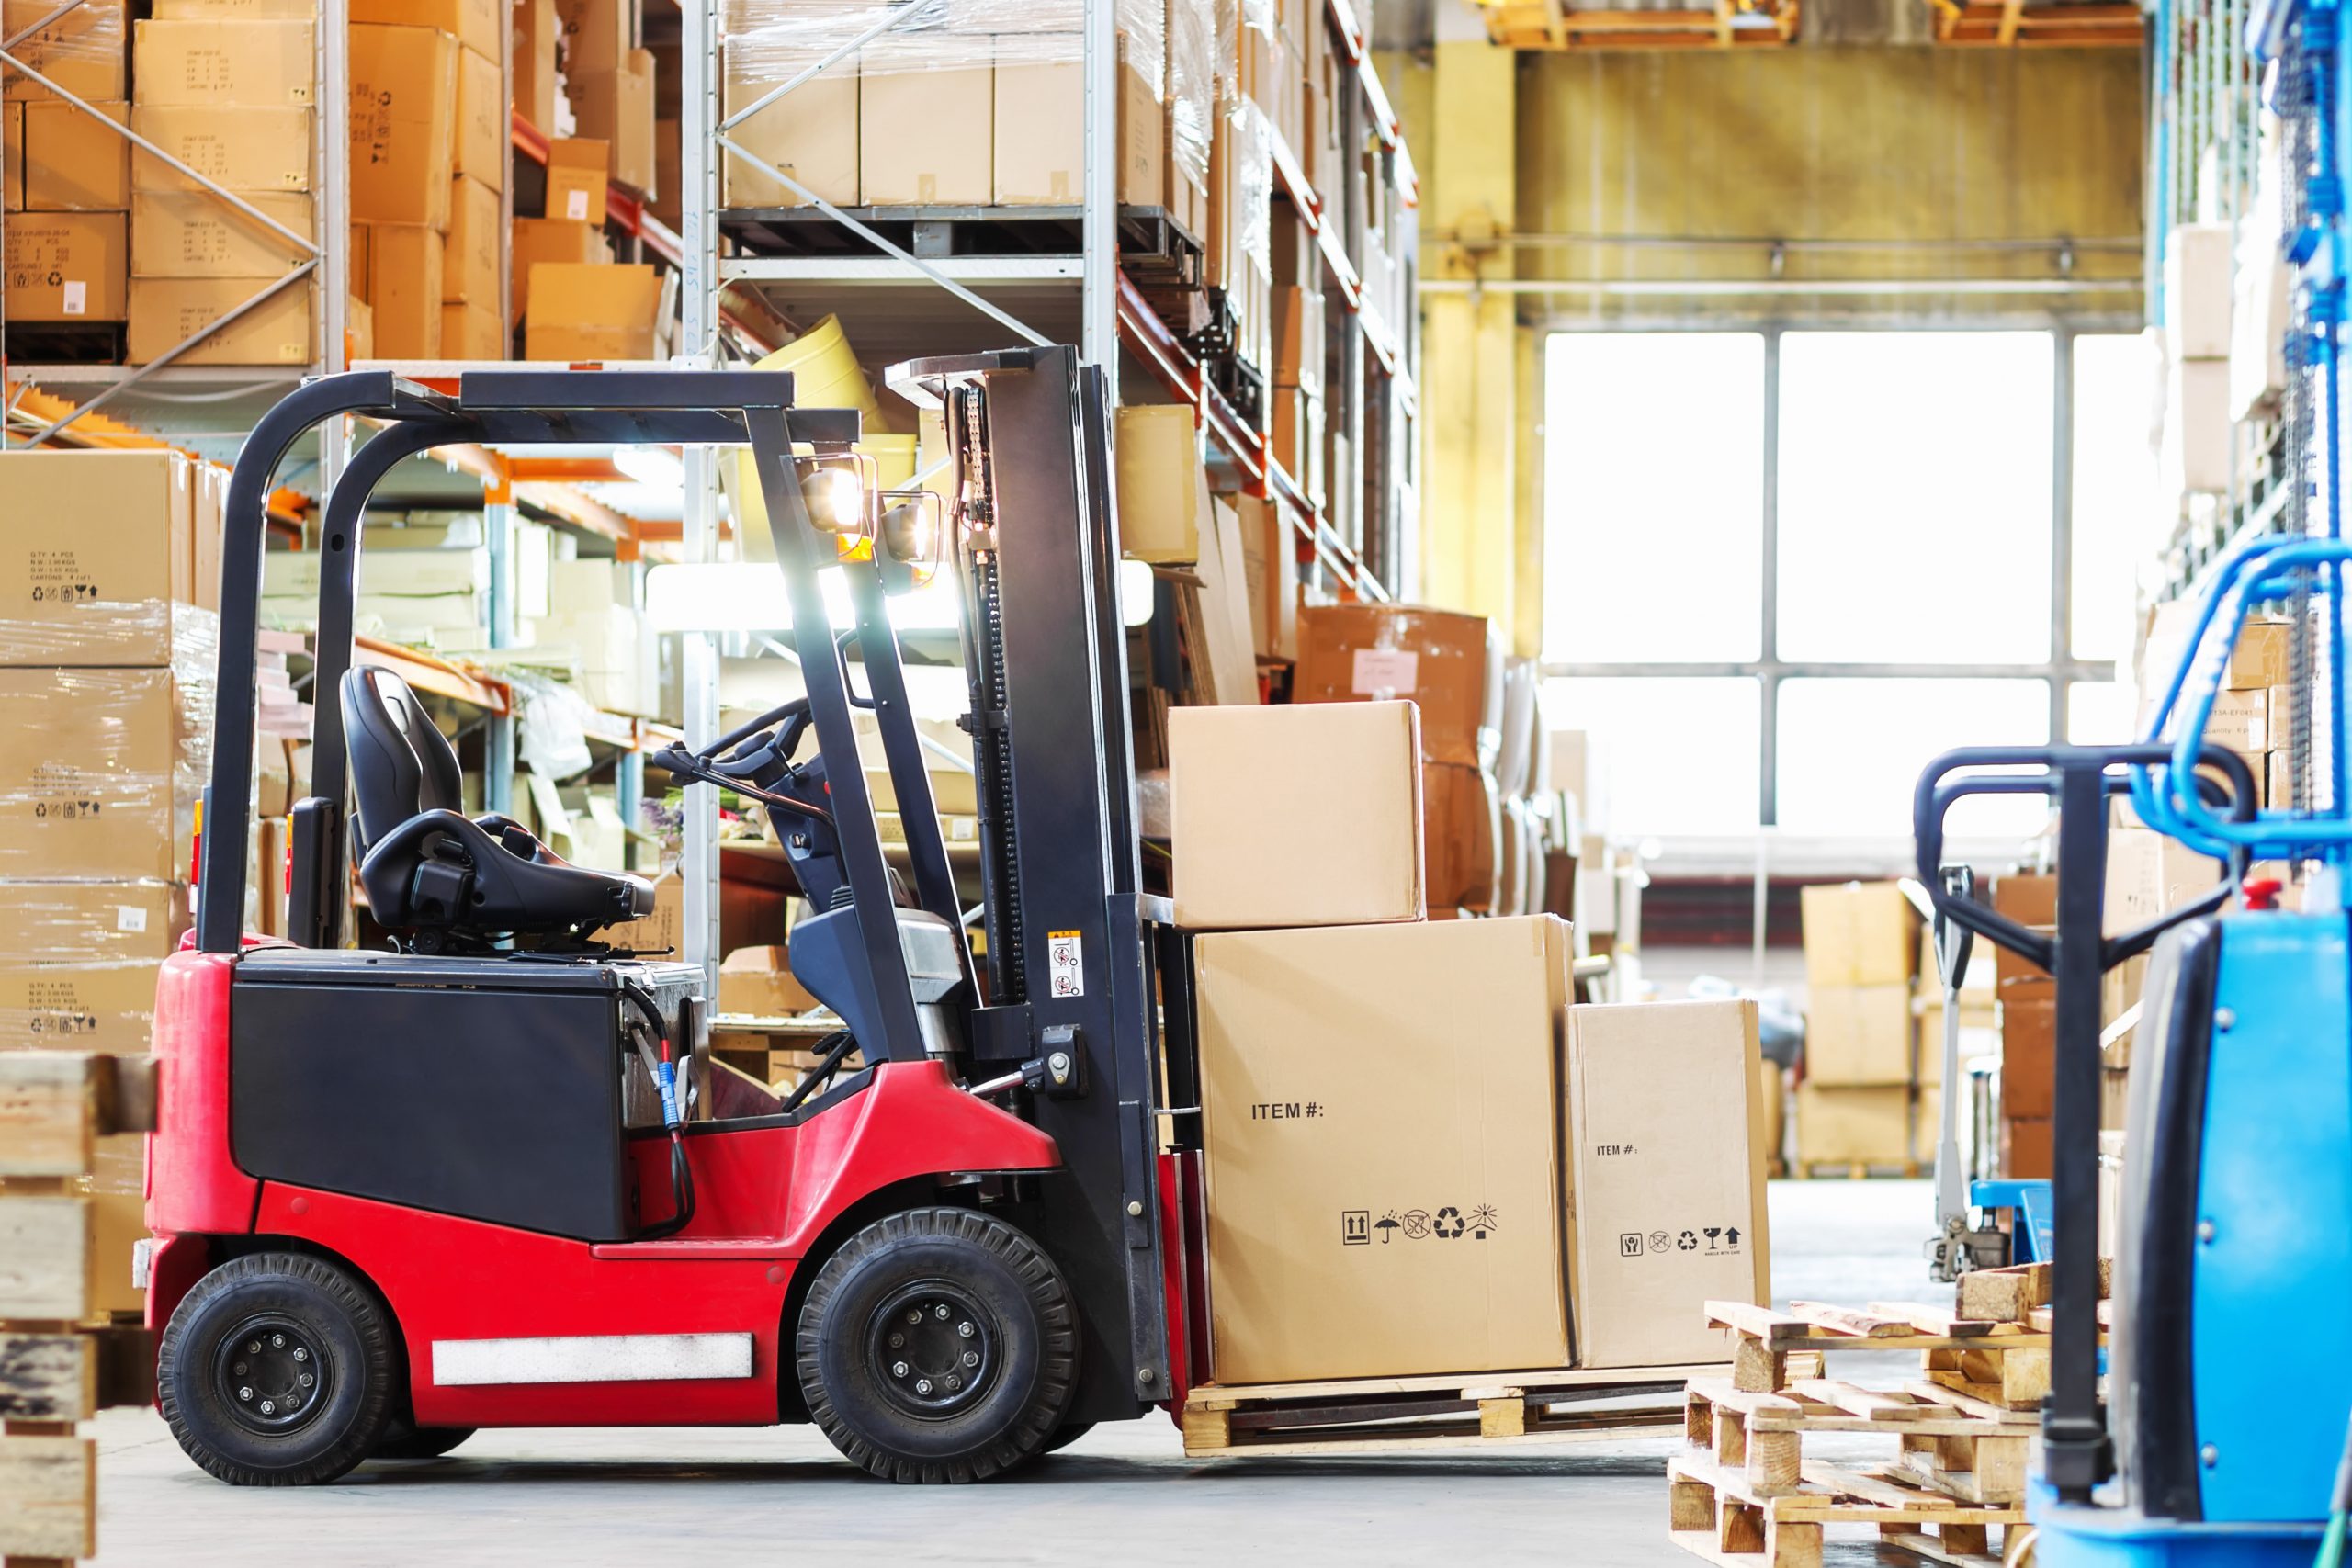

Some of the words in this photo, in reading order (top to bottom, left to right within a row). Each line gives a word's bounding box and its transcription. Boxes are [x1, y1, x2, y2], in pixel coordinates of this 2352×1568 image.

[1251, 1103, 1300, 1120] ITEM
[1306, 1102, 1324, 1118] #:
[1597, 1145, 1620, 1156] ITEM
